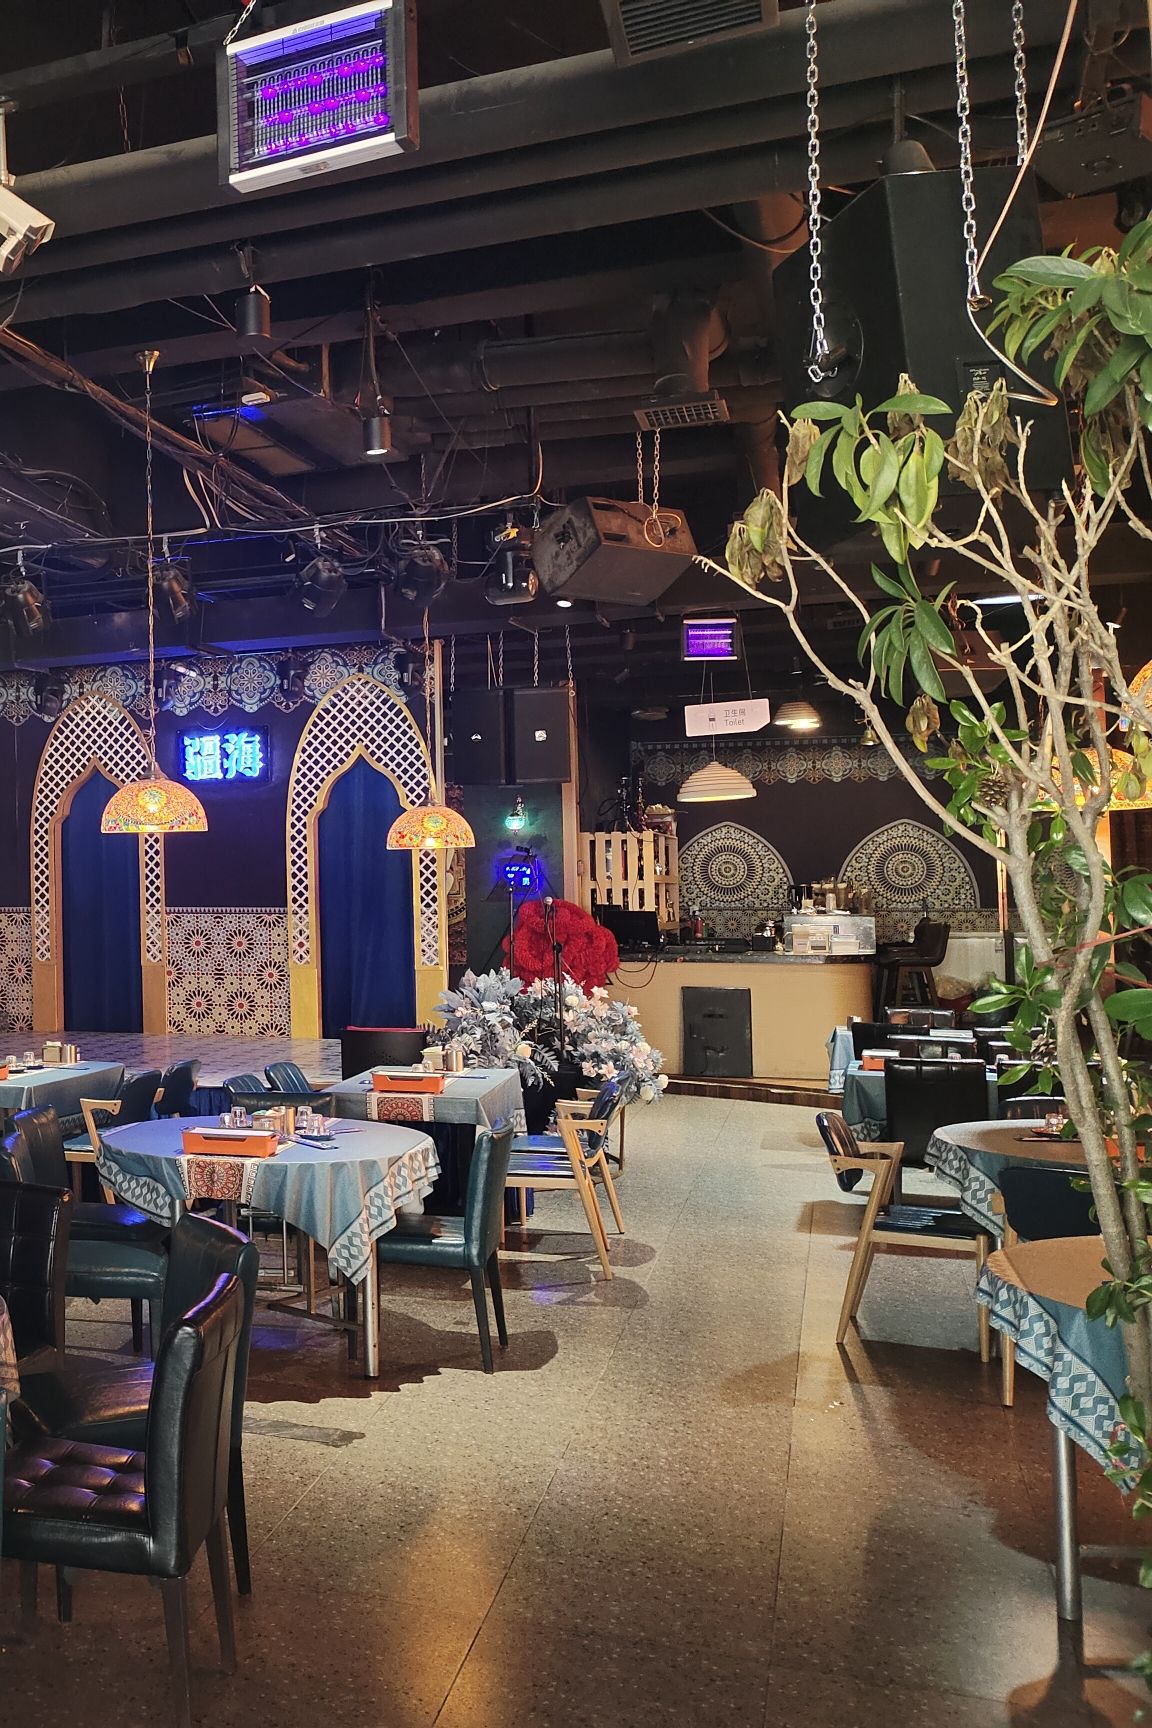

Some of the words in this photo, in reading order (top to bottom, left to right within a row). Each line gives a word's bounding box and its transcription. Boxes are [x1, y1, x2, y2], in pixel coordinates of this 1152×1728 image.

[723, 708, 746, 717] 卫生间
[724, 718, 745, 726] Toilet
[183, 732, 264, 781] 疆海
